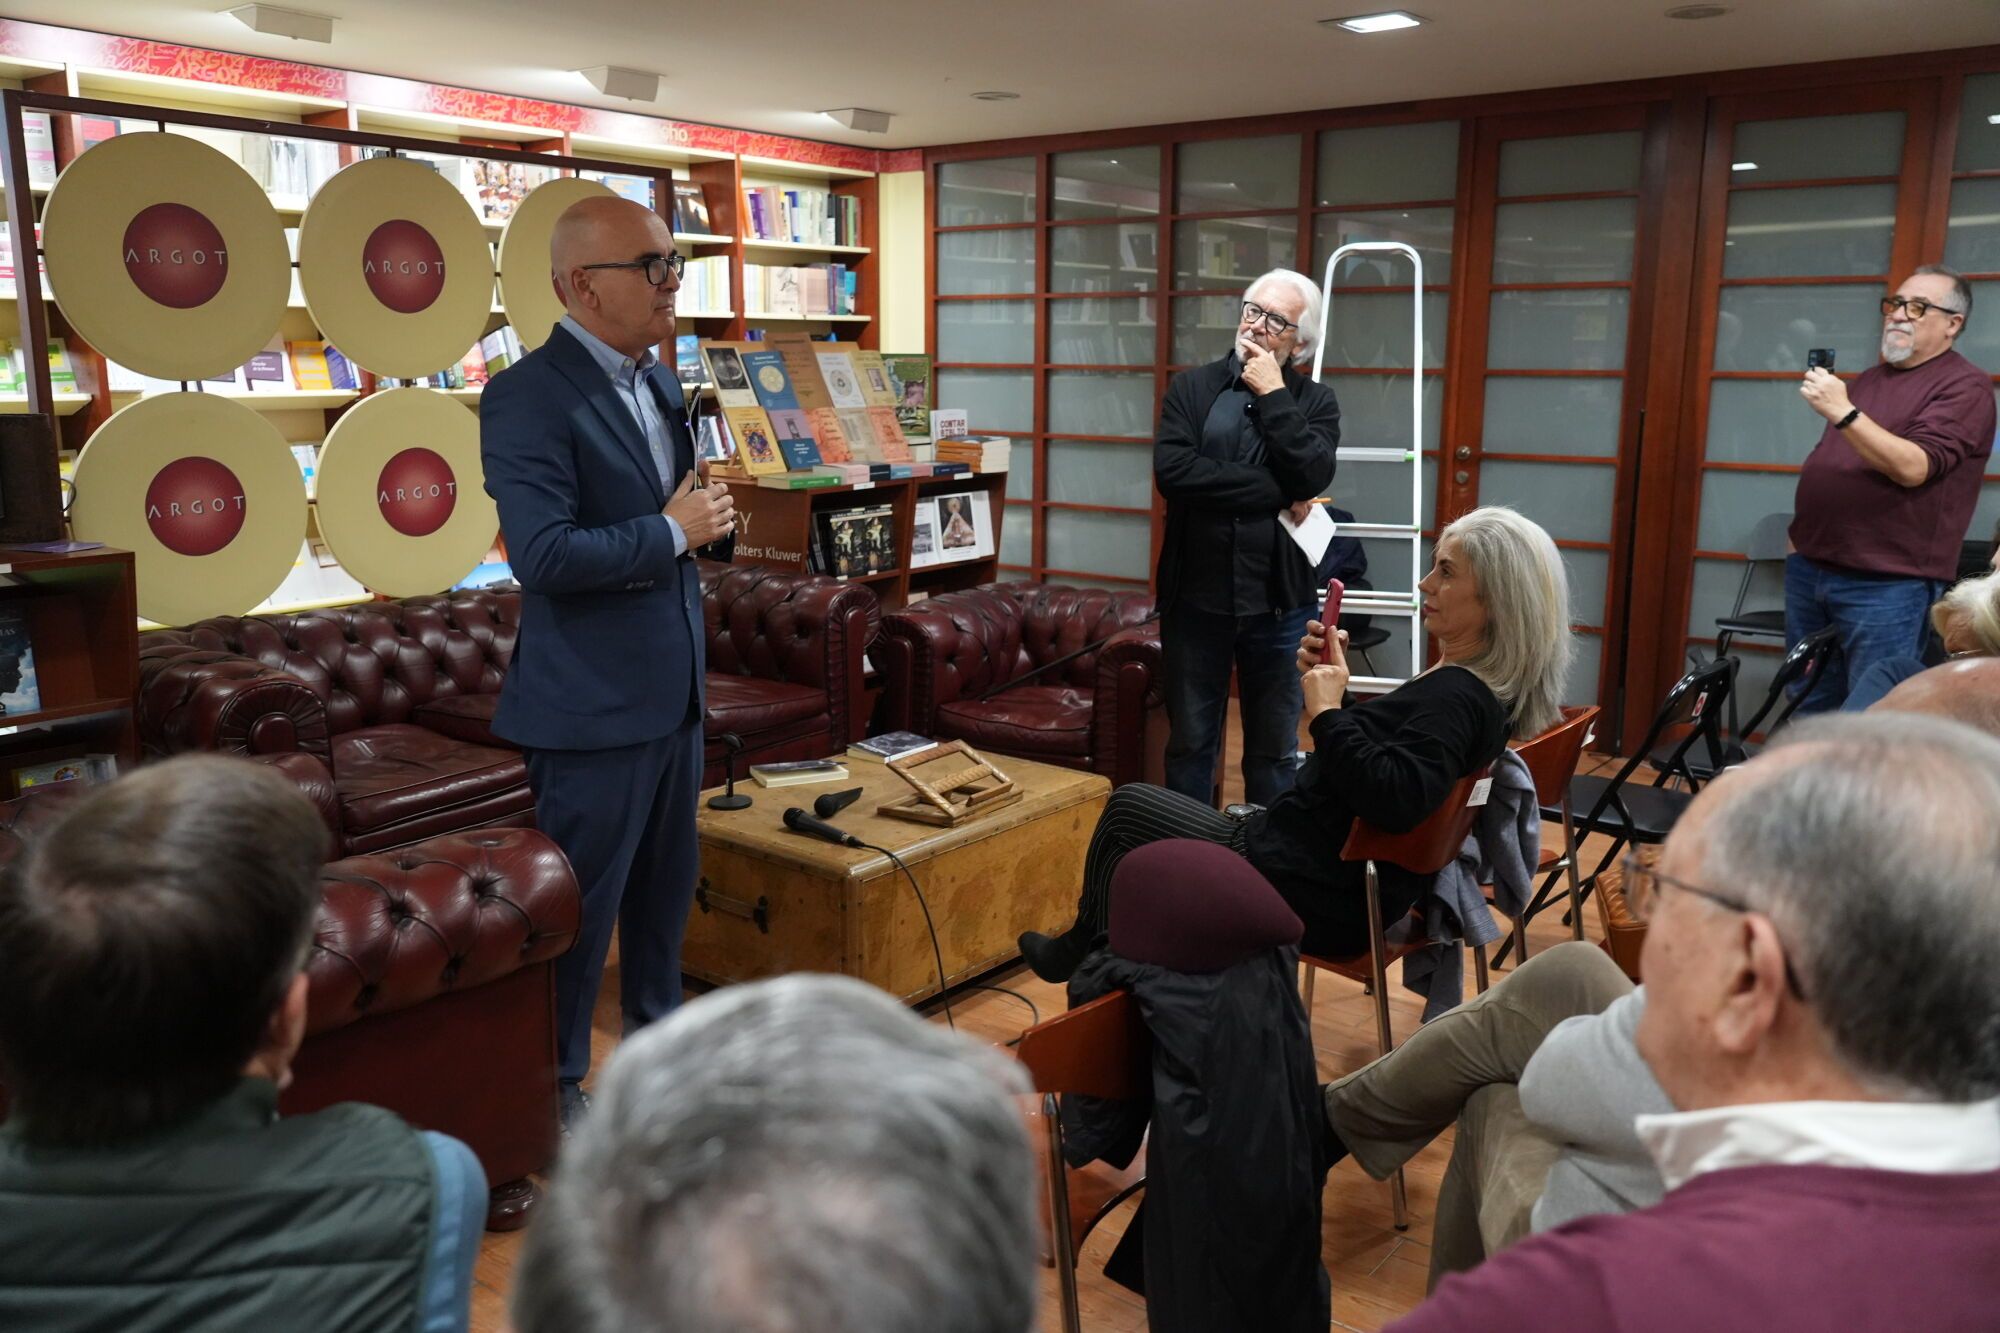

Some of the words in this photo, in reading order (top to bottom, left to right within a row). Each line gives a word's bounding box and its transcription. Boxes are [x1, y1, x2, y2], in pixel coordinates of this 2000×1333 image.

[288, 71, 344, 90] ARGOT
[125, 248, 226, 265] ARGOT
[364, 260, 444, 275] ARGOT
[940, 419, 965, 428] CONTAR
[379, 482, 455, 503] ARGOT
[148, 495, 244, 519] ARGOT
[733, 543, 763, 558] olters
[765, 546, 802, 562] Kluwer
